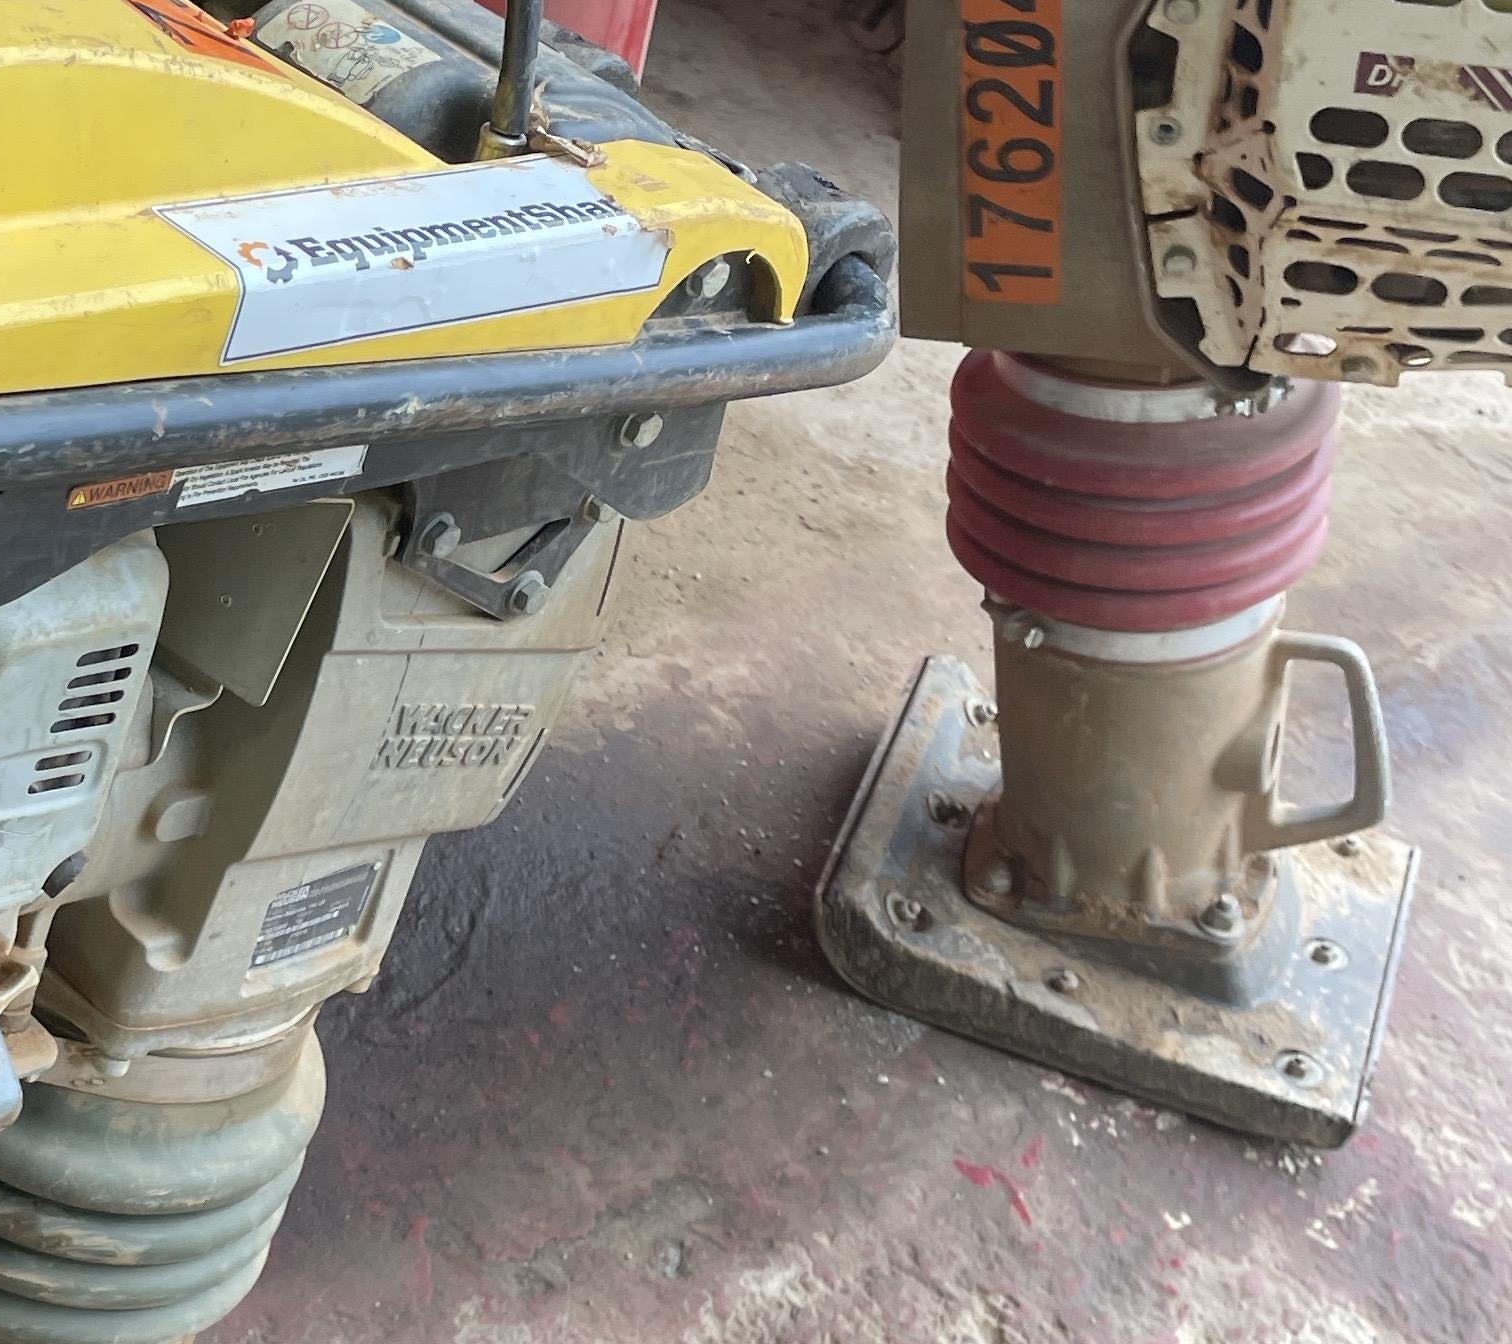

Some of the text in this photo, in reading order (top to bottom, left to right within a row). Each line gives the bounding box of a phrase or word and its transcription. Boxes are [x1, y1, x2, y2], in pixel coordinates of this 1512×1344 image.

[89, 474, 167, 502] WARNING
[394, 702, 537, 737] WACKER
[369, 735, 526, 769] NEUSON
